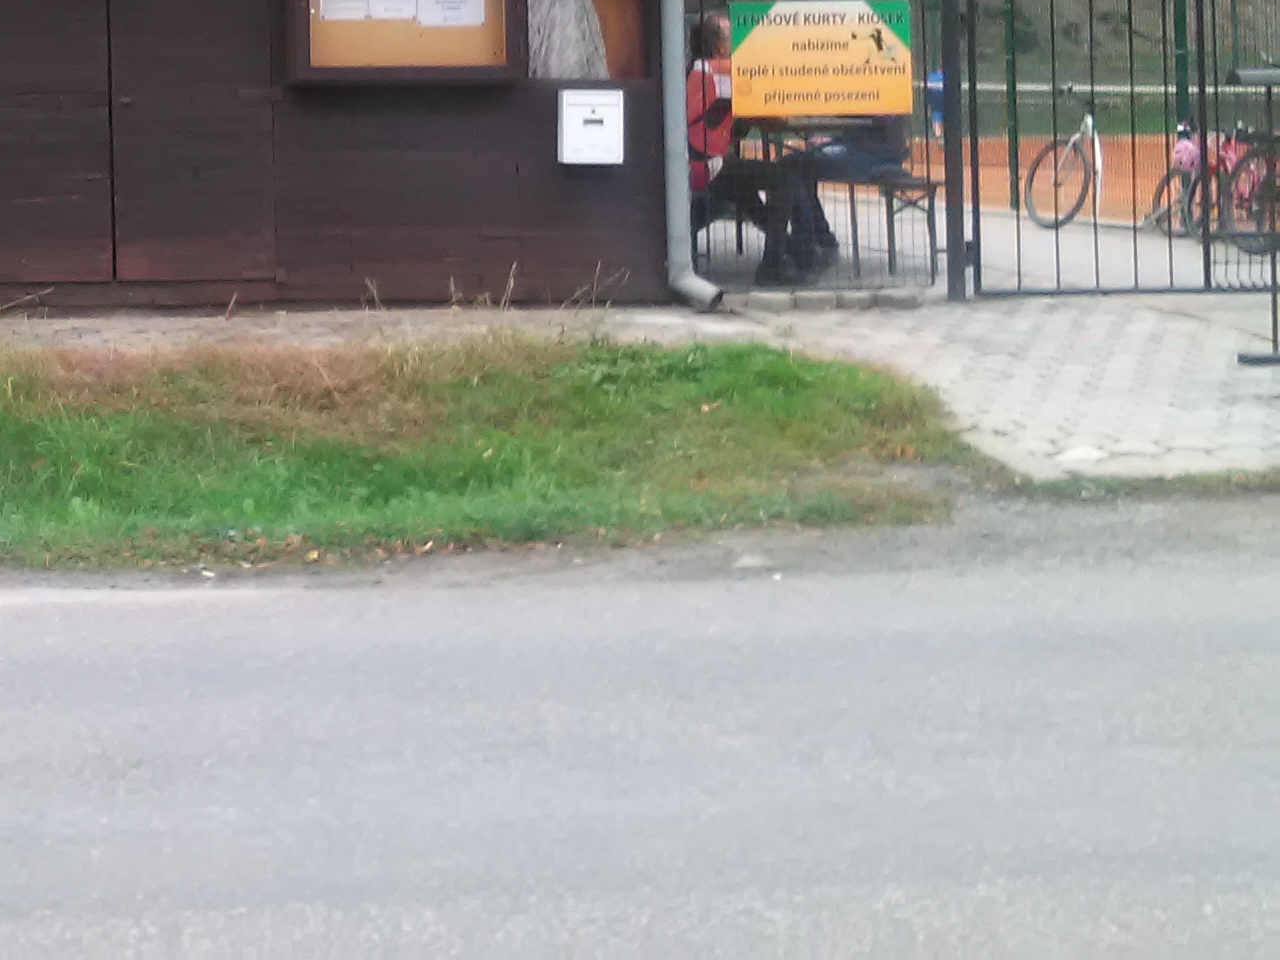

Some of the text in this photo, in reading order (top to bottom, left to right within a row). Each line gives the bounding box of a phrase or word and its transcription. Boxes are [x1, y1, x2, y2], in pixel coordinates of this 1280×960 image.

[736, 10, 799, 26] TENISOVÉ
[803, 12, 847, 25] KURTY
[858, 11, 904, 25] KIOSEK
[737, 65, 770, 80] teplé
[779, 64, 829, 76] studené
[832, 62, 906, 76] občerstvení
[764, 90, 880, 105] příjemné posezení
